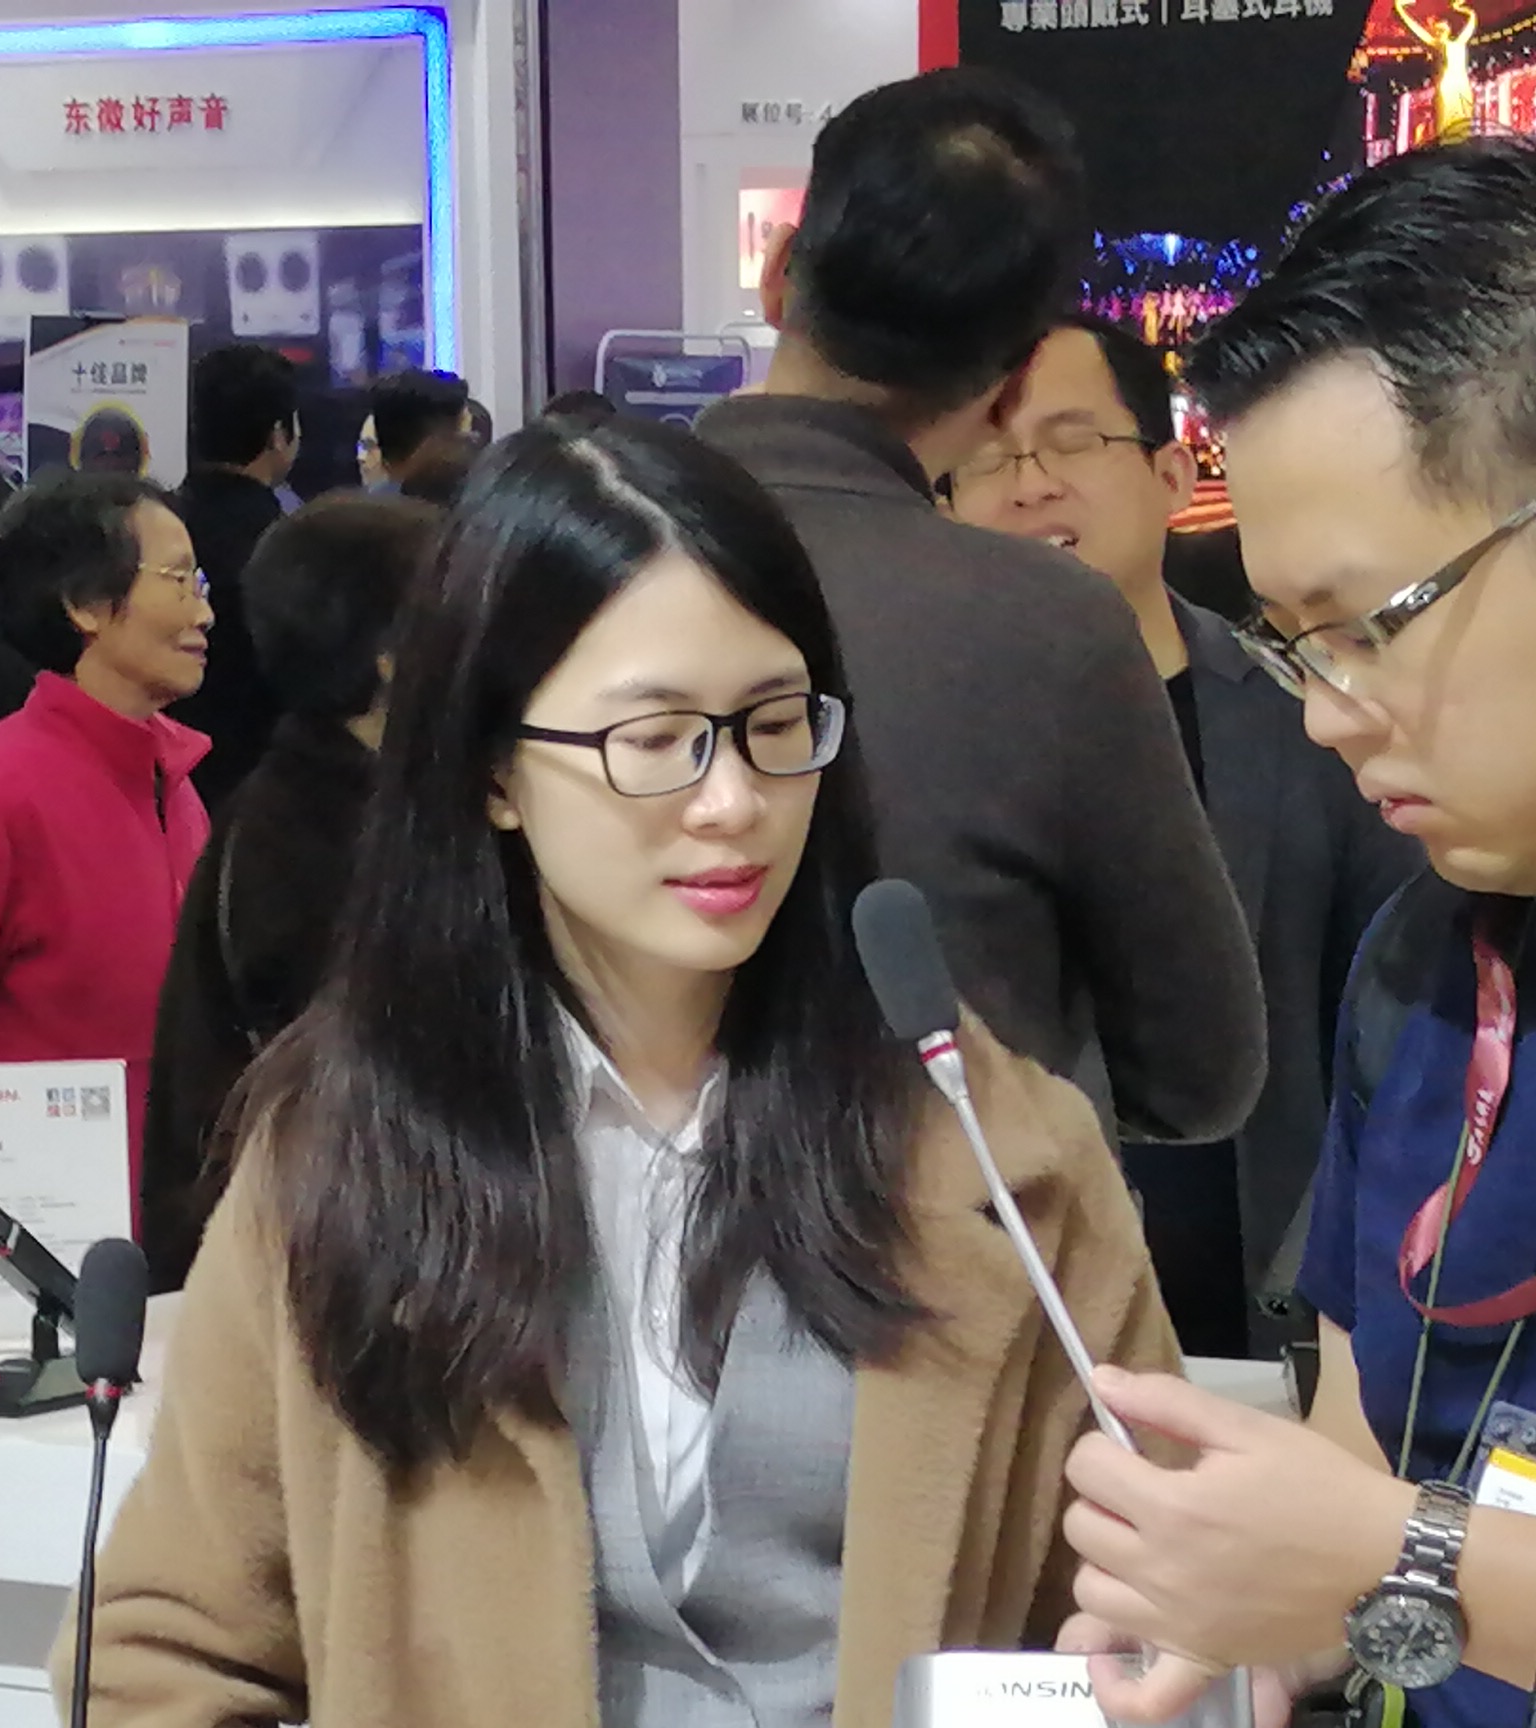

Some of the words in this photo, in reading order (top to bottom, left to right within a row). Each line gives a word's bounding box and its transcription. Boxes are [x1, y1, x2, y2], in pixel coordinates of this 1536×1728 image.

[63, 93, 228, 135] 东微好声音
